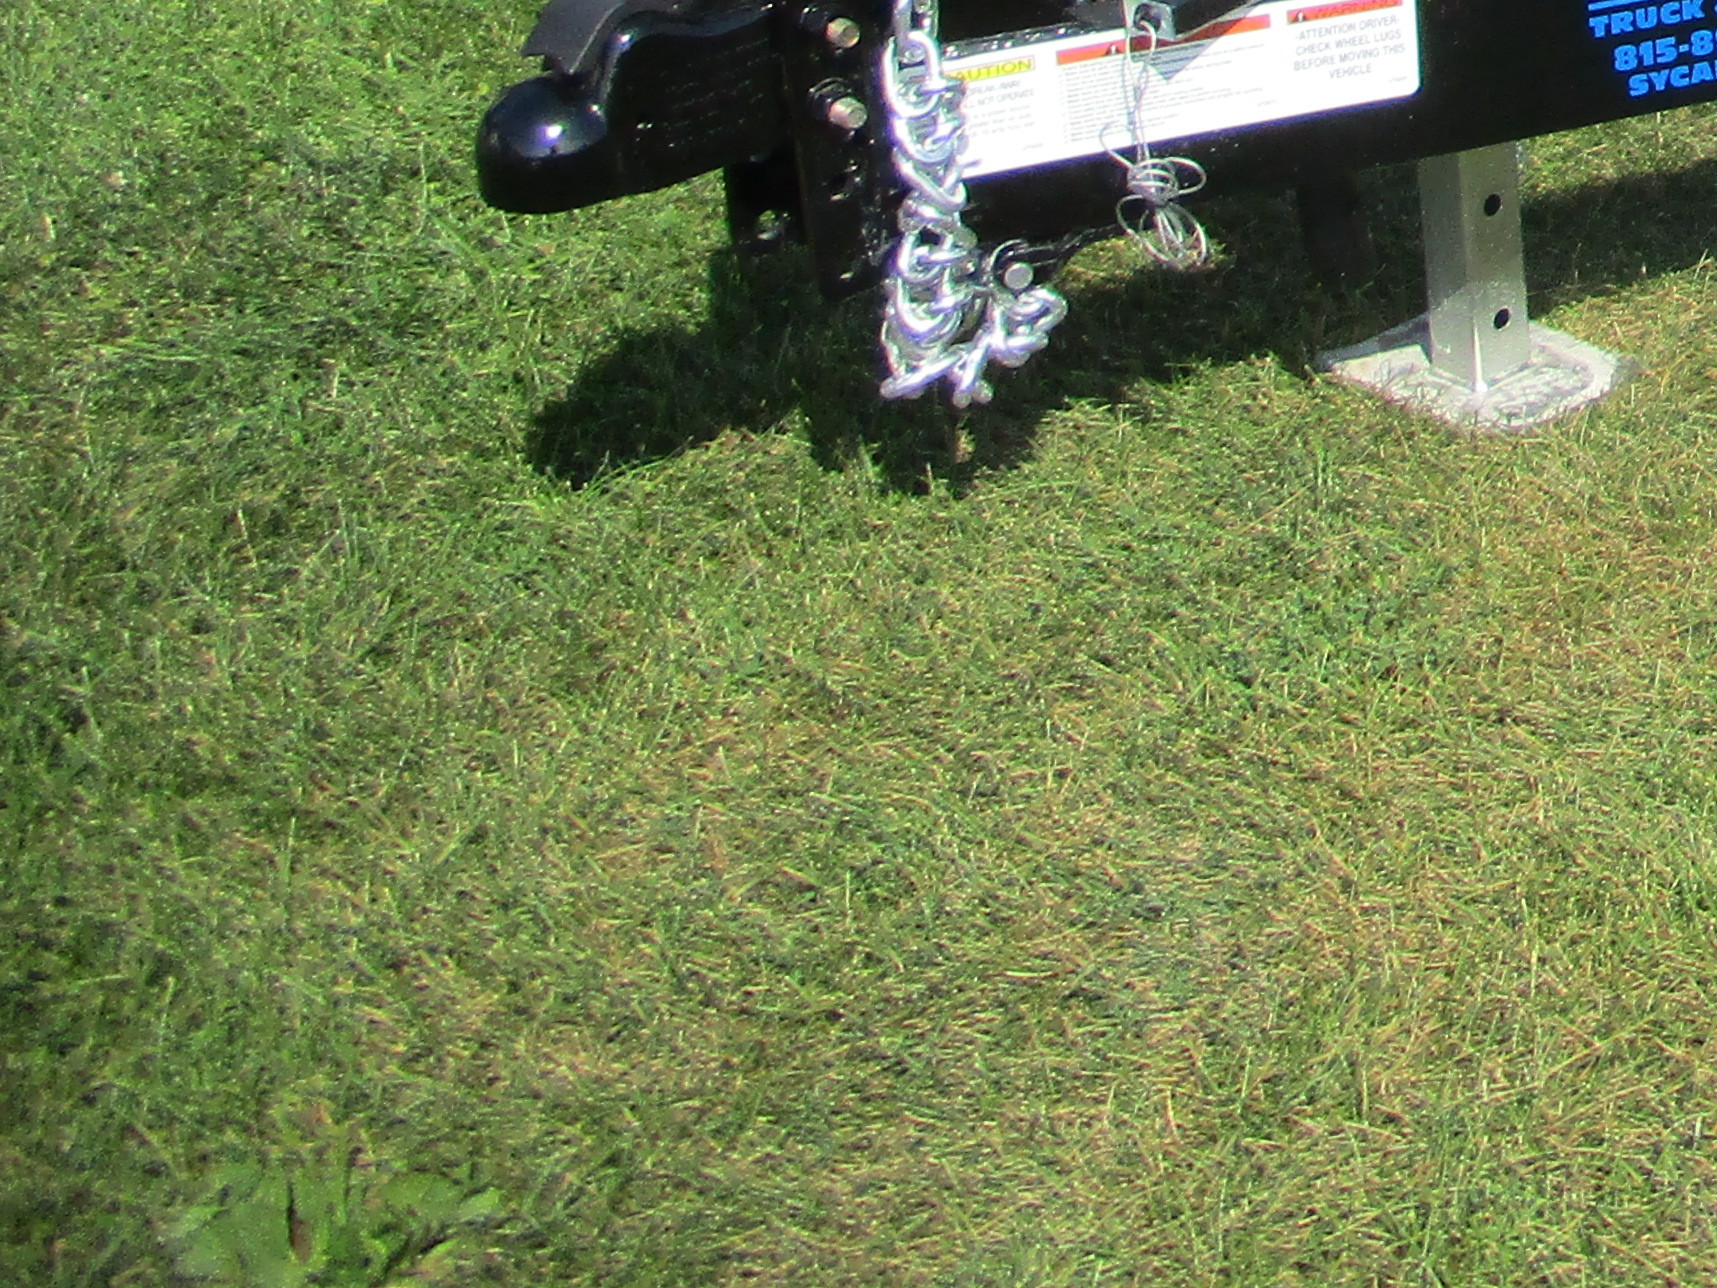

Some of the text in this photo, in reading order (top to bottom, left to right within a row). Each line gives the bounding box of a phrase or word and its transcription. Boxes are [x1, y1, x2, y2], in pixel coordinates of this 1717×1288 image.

[1296, 29, 1401, 56] CHECK WHEEL LUGS
[1294, 55, 1336, 71] BEFORE
[1340, 48, 1380, 63] MOVING
[1329, 63, 1372, 79] VEHICLE
